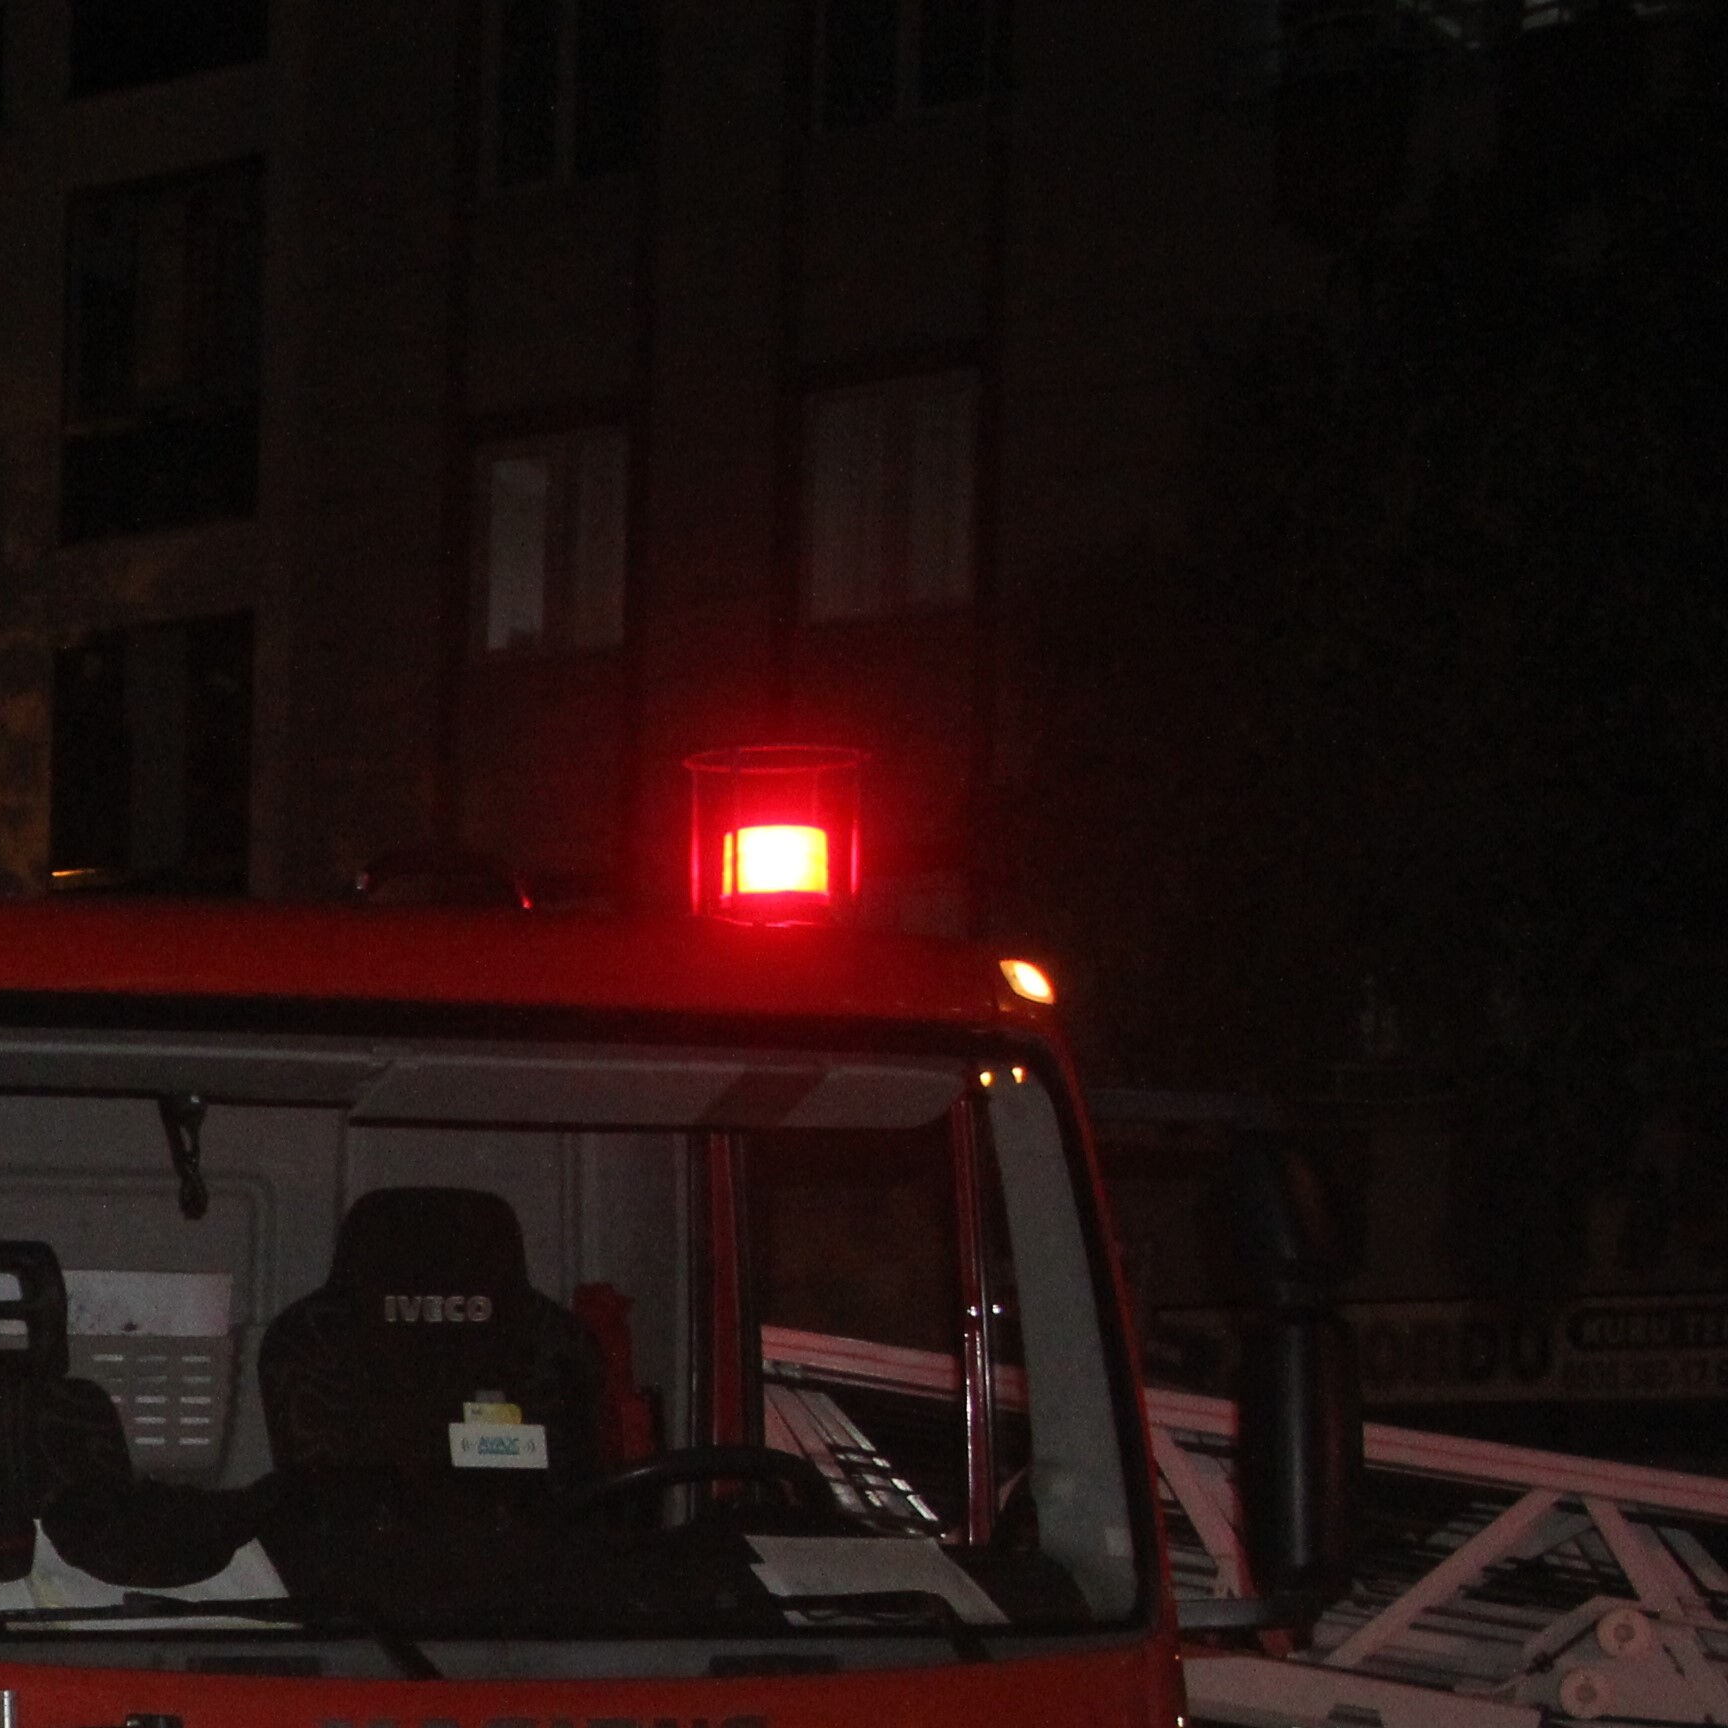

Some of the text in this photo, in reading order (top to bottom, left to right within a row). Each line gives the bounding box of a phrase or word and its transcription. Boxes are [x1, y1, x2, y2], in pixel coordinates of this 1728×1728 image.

[384, 1294, 493, 1324] IVECO
[1582, 1312, 1728, 1345] KURU TE
